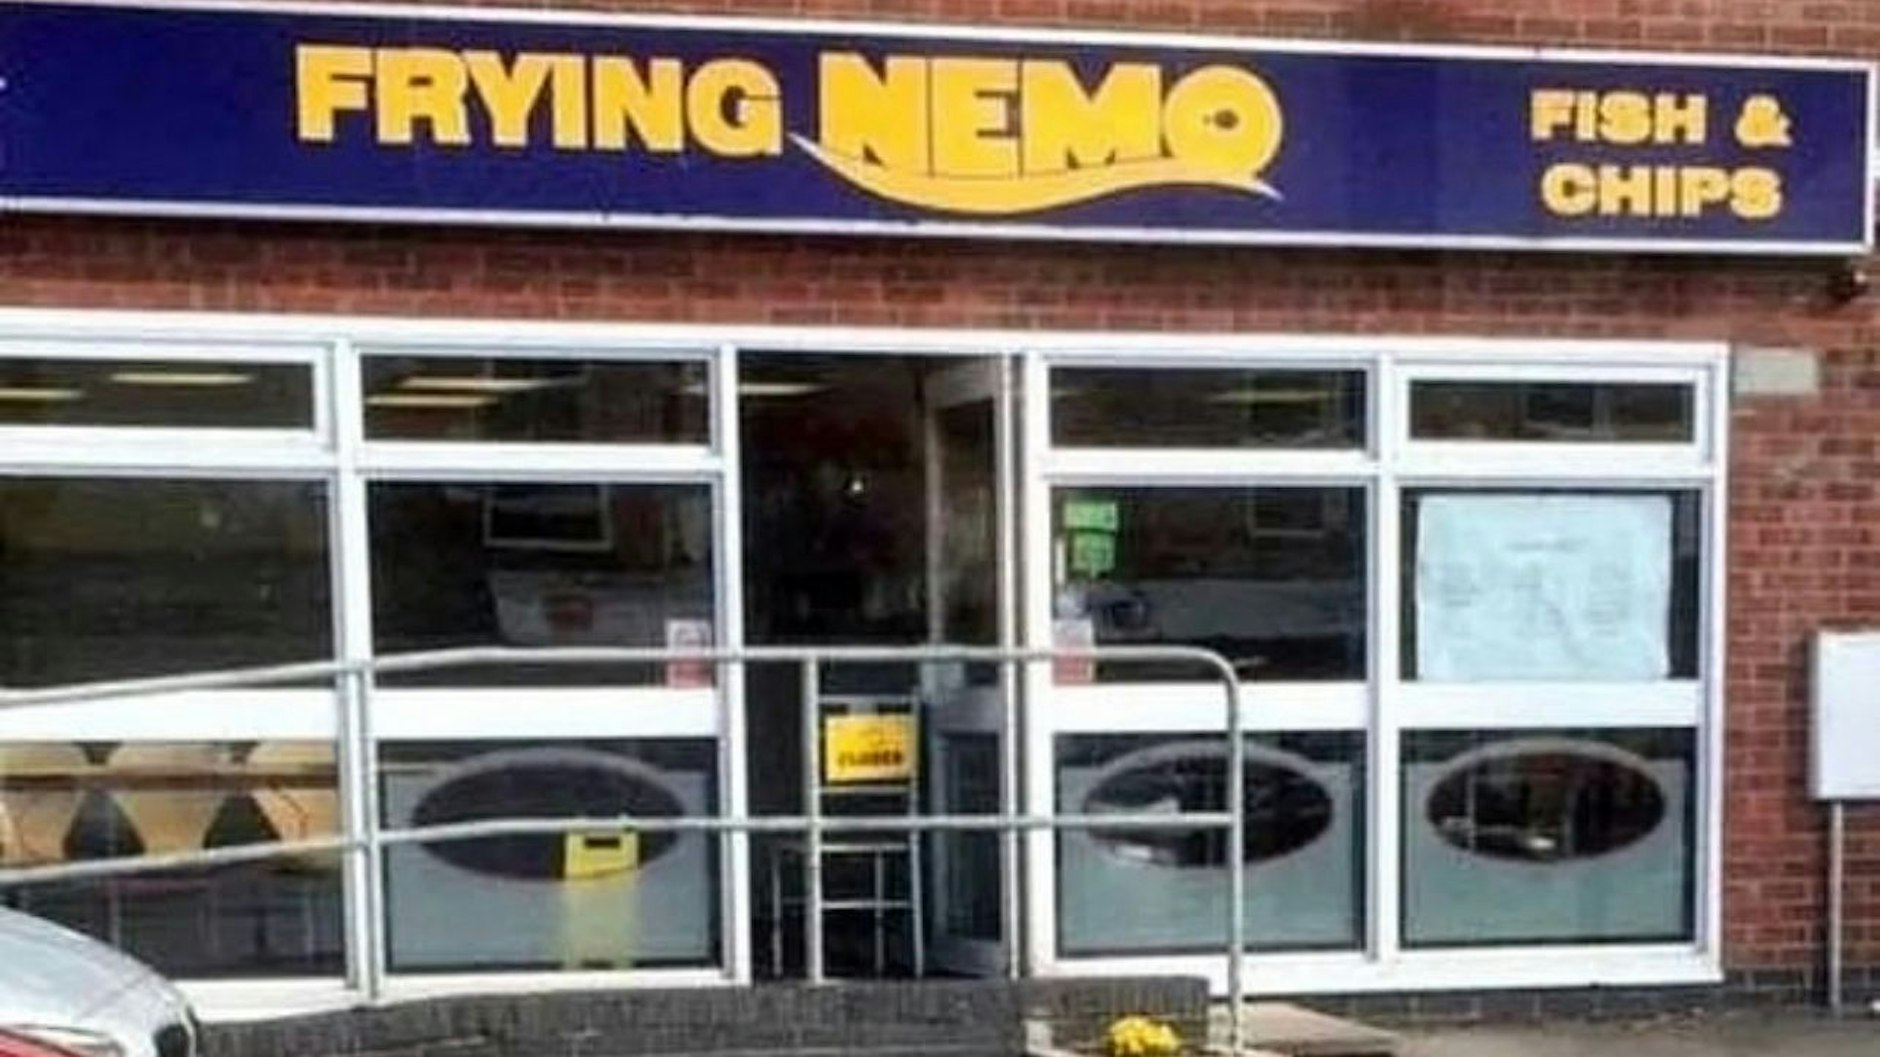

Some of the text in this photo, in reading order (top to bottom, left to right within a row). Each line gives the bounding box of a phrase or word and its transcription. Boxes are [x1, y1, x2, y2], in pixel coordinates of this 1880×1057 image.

[296, 45, 1283, 188] FRYING NEMO
[1530, 90, 1793, 148] FISH &
[1541, 162, 1784, 220] CHIPS
